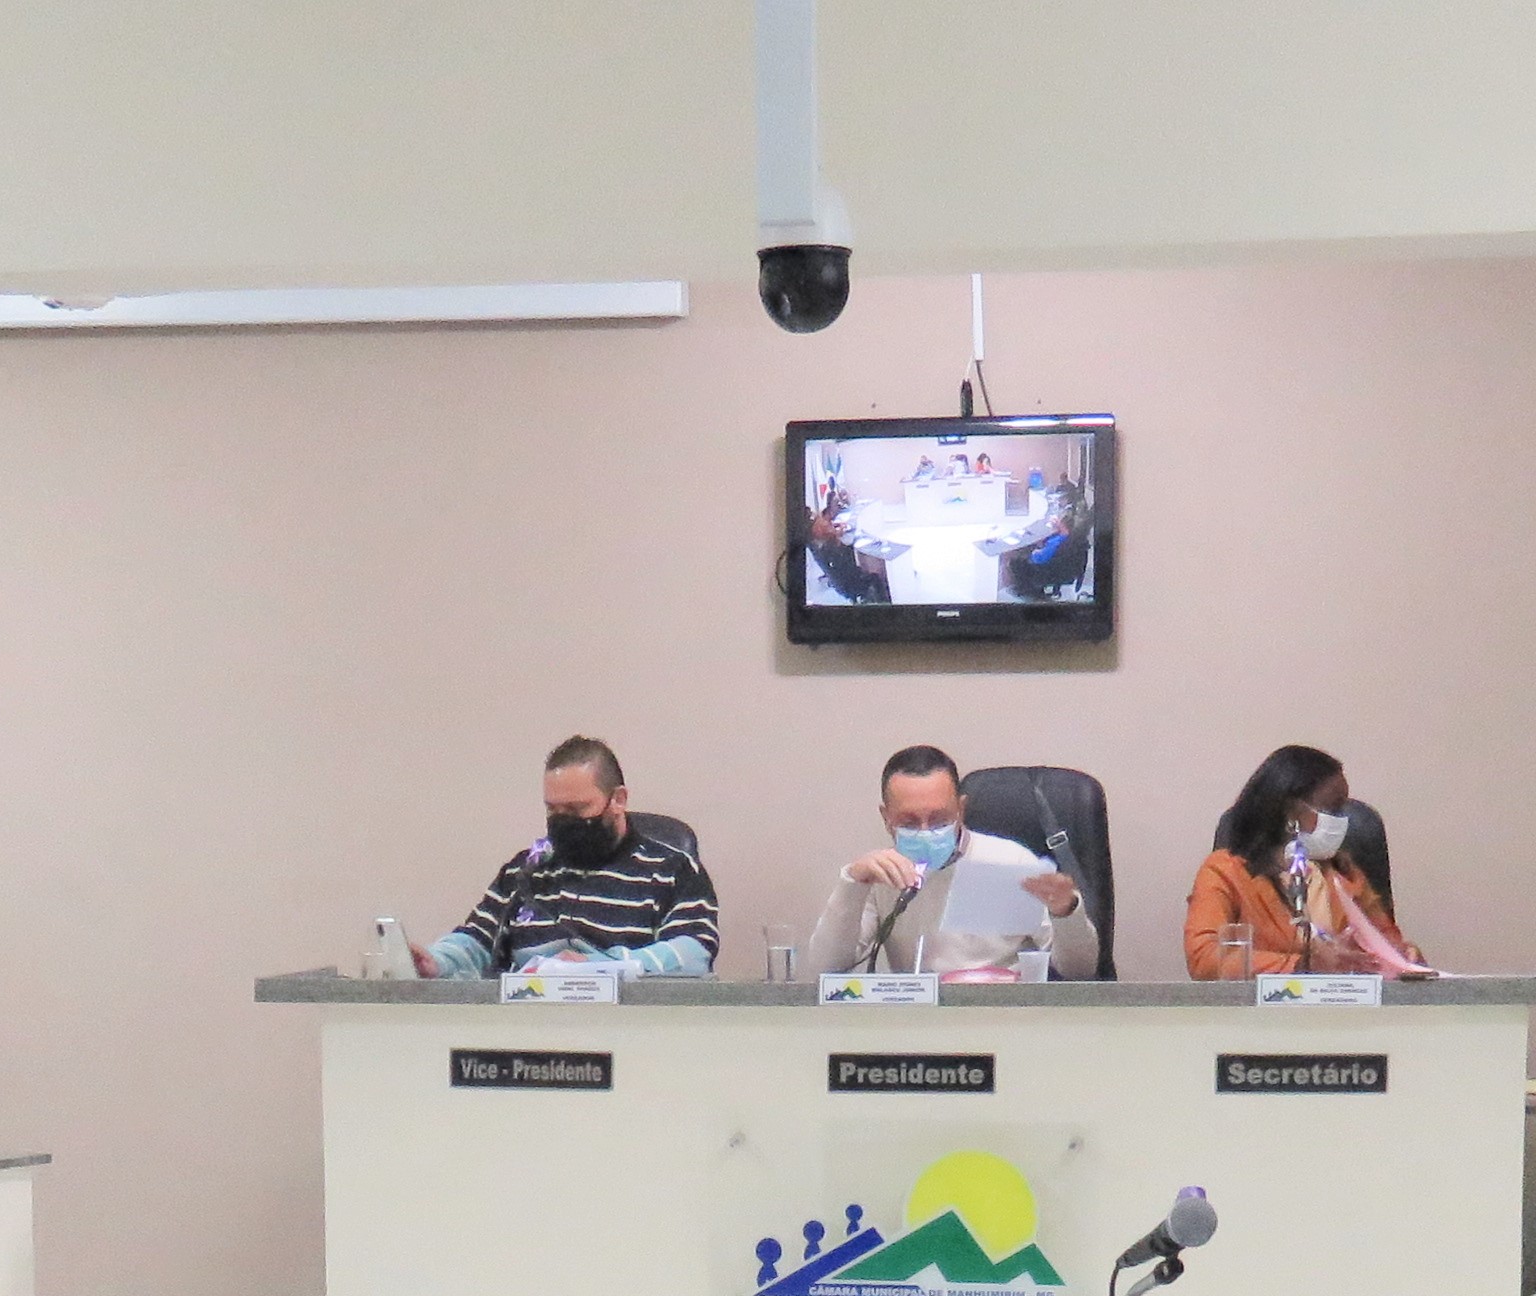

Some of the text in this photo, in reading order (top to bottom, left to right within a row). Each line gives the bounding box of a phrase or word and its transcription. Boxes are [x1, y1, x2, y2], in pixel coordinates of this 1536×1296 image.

[461, 1058, 498, 1079] Vice
[513, 1059, 602, 1082] Presidente
[839, 1062, 984, 1084] Presidente
[1228, 1062, 1378, 1085] Secretário
